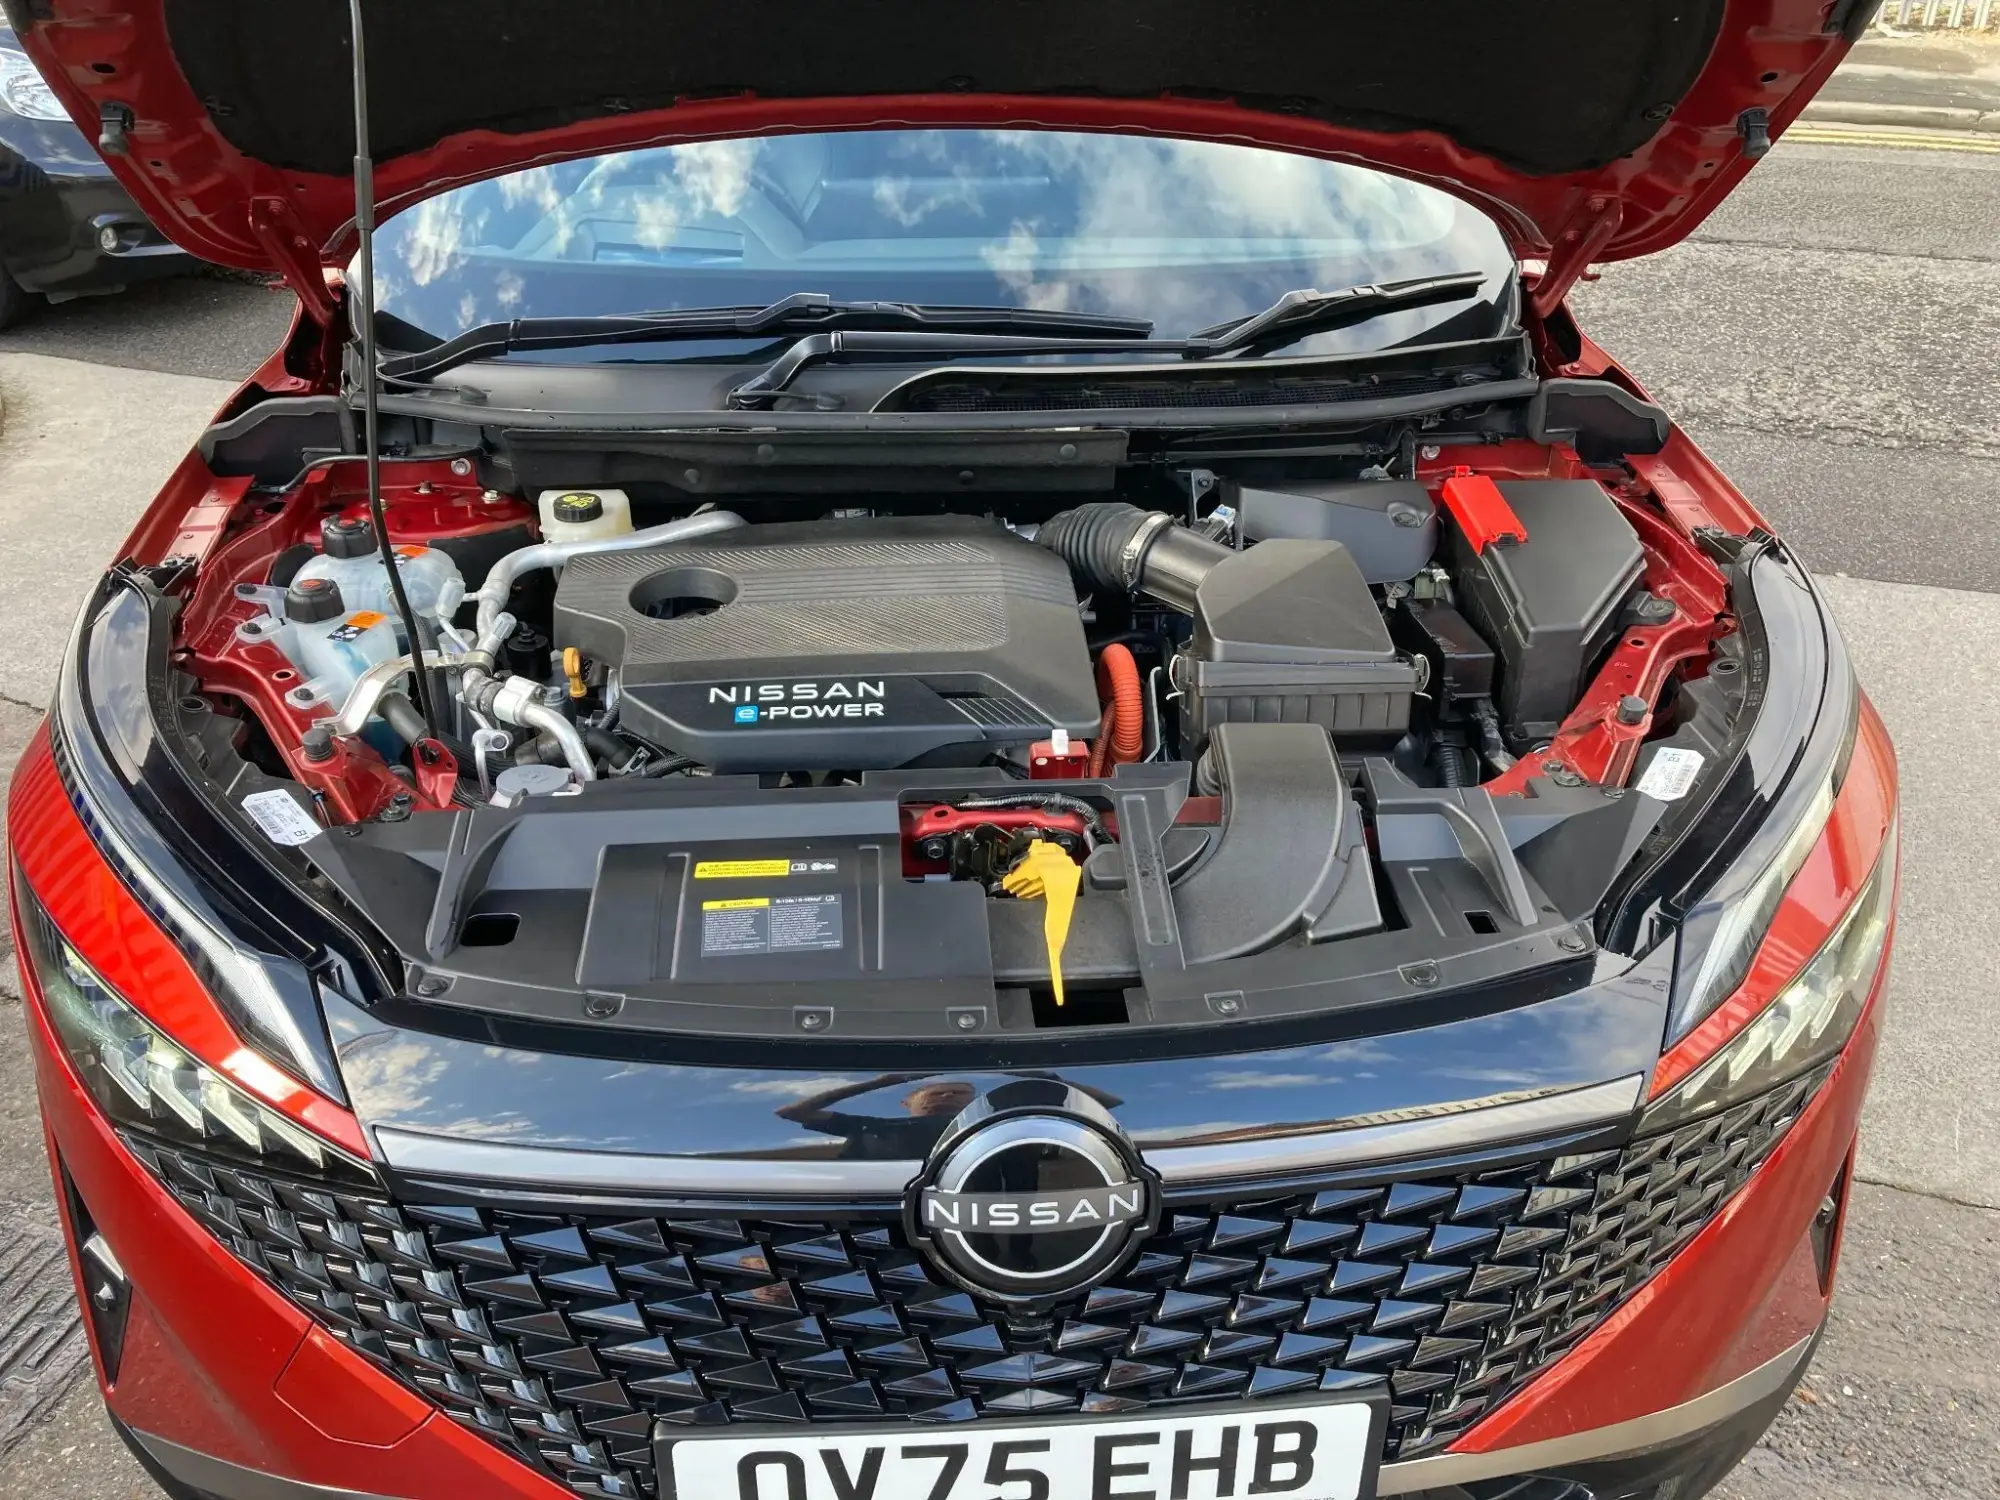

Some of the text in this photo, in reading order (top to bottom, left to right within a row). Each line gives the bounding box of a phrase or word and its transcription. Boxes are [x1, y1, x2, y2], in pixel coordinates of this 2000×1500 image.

[709, 681, 885, 703] NISSAN
[736, 702, 885, 720] e-POWER
[928, 1189, 1138, 1226] NISSAN
[736, 1420, 1319, 1500] OV75 EHB
